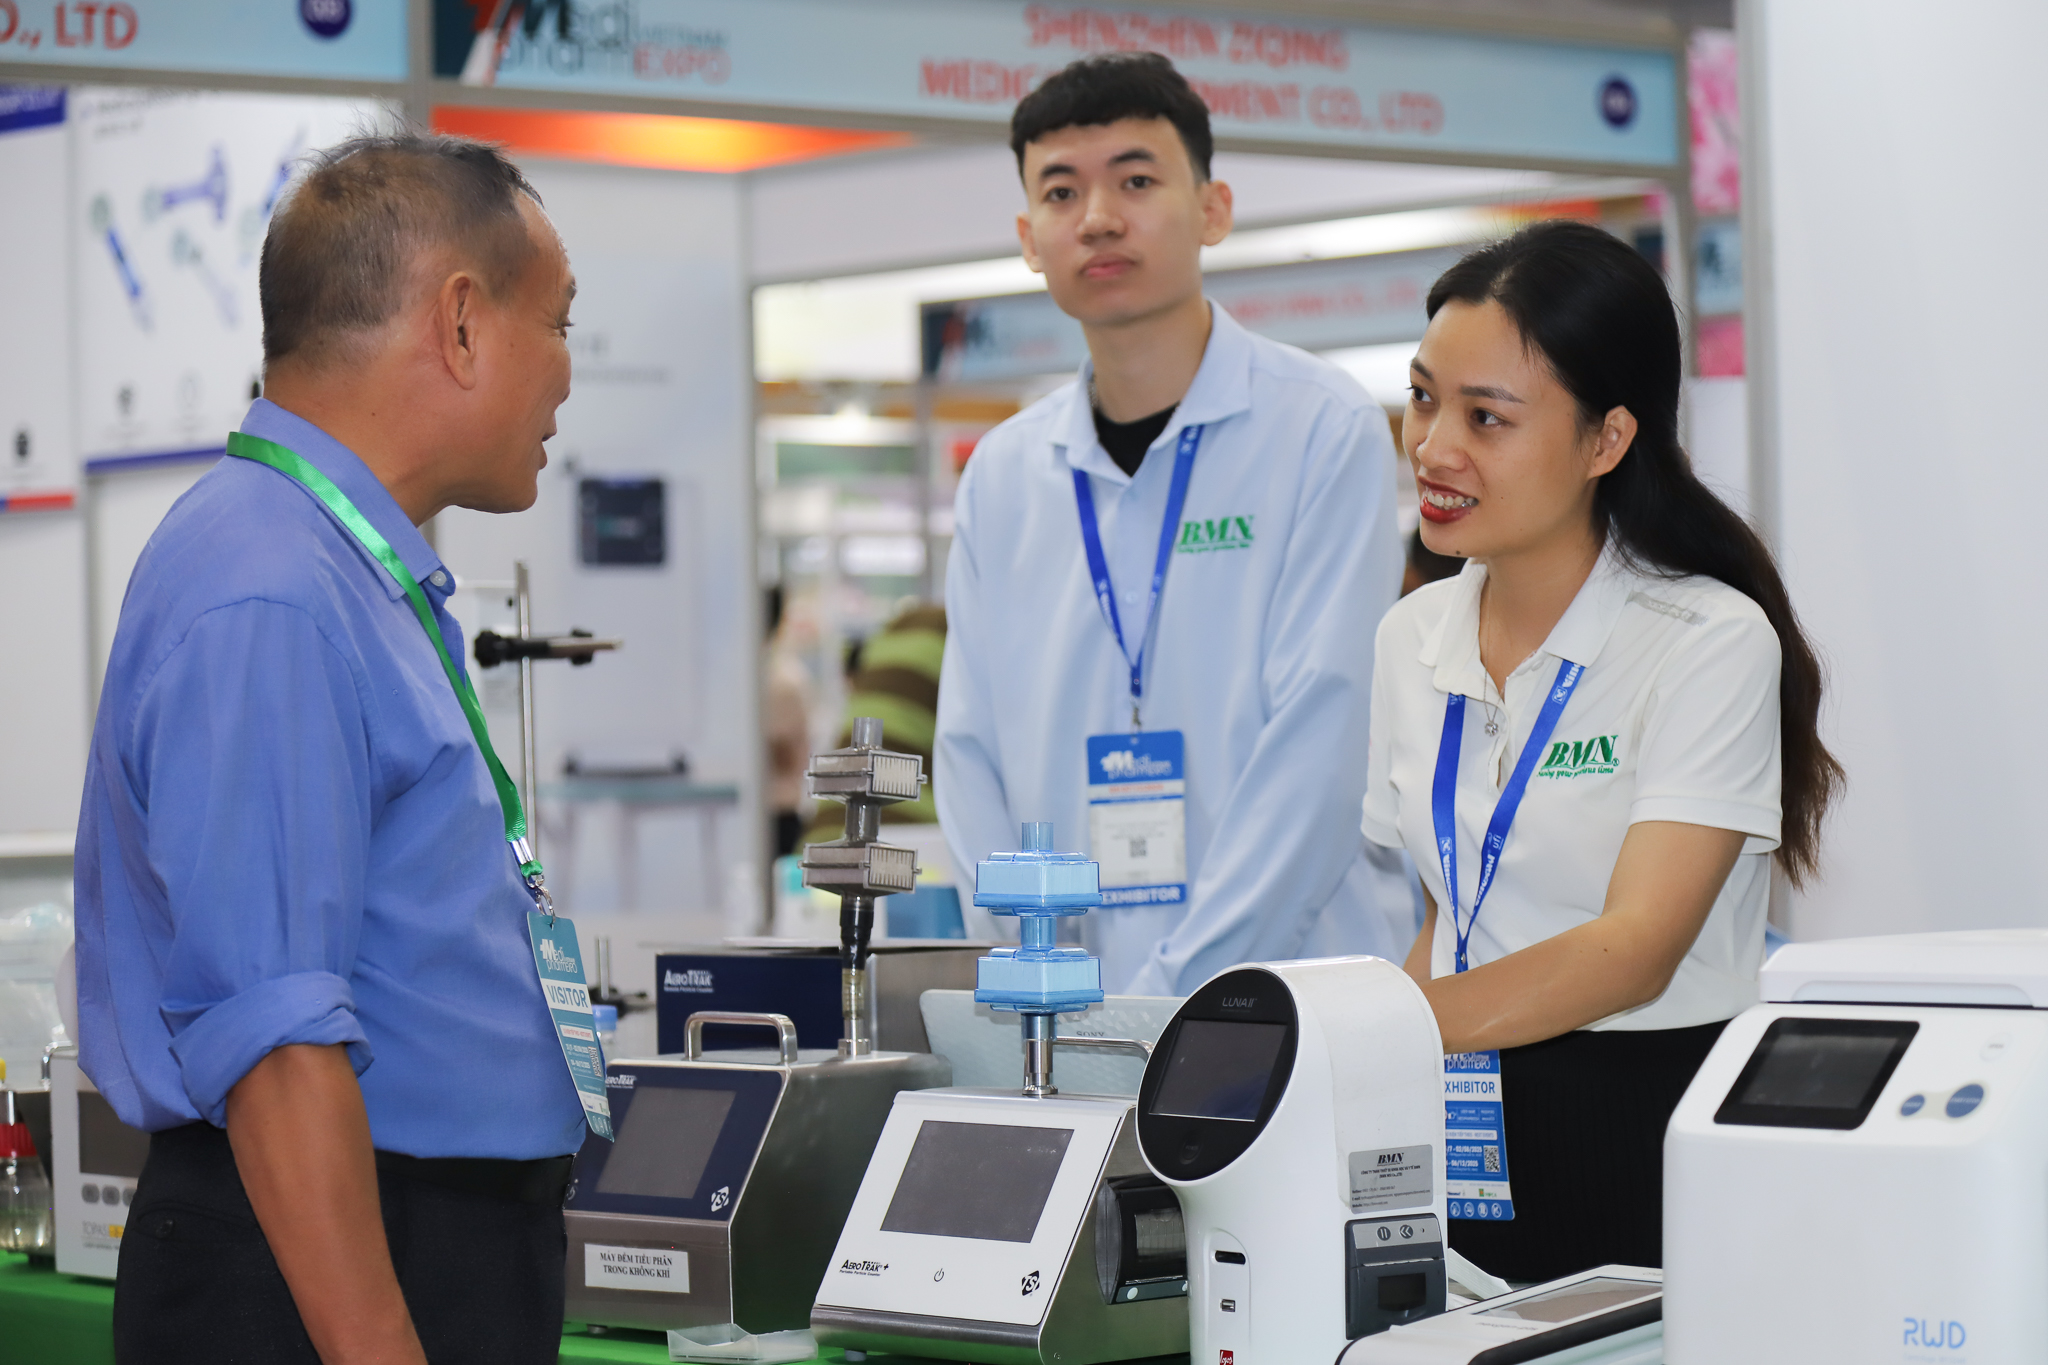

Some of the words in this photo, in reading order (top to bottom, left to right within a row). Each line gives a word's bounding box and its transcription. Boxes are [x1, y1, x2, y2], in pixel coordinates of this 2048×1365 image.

[55, 2, 139, 49] LTD
[1024, 4, 1218, 60] SHENZHEN
[1181, 514, 1255, 546] BMN
[1542, 734, 1619, 768] BMN
[546, 984, 589, 1008] VISITOR
[1444, 1080, 1496, 1094] XHIBITOR
[1377, 1152, 1405, 1165] BMN
[600, 1250, 616, 1262] MÁY
[603, 1265, 628, 1275] TRONG
[629, 1266, 655, 1277] KHÔNG
[656, 1267, 671, 1278] KHÍ
[1903, 1317, 1967, 1350] RWD
